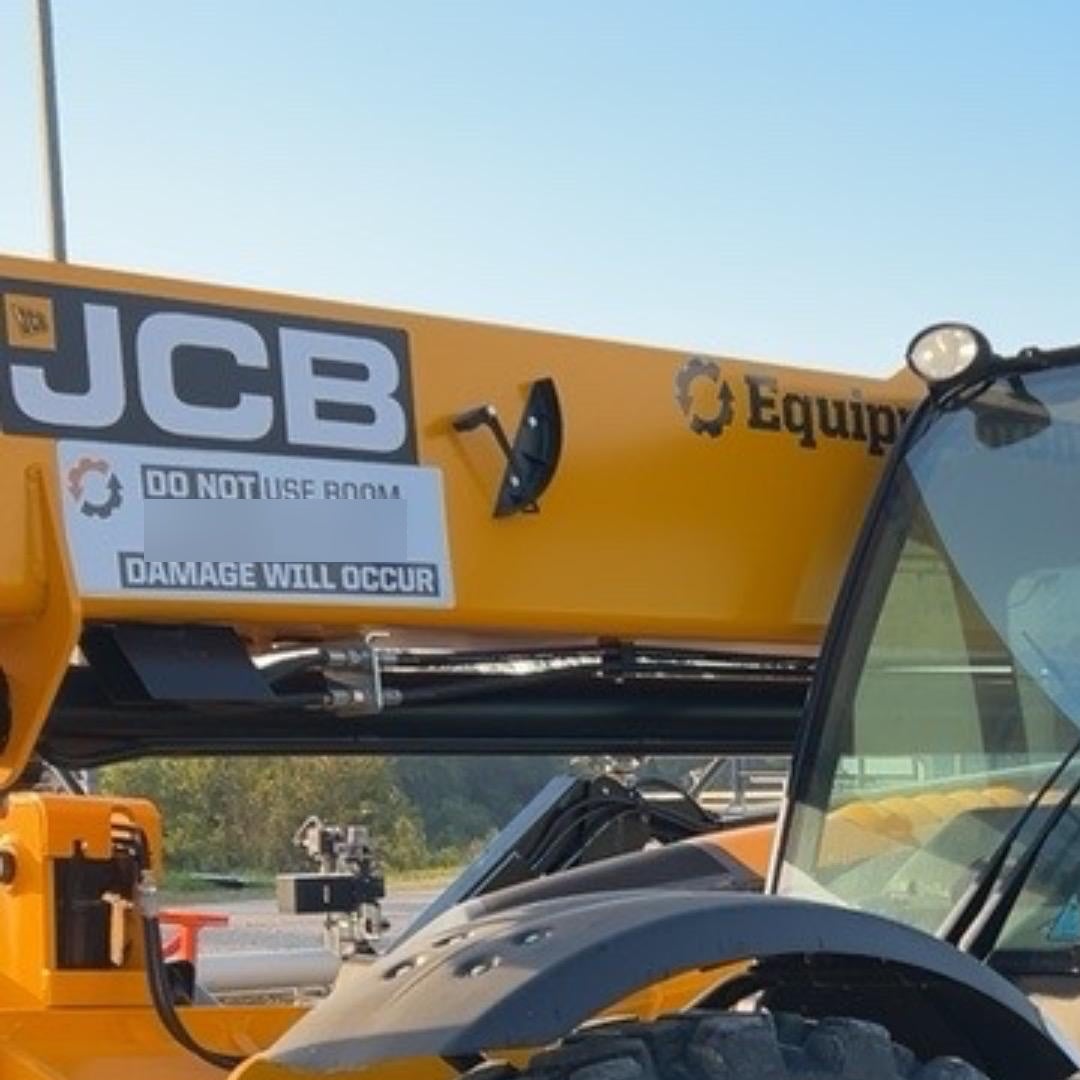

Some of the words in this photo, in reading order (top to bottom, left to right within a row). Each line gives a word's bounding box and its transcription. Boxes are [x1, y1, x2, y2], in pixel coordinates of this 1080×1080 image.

[10, 303, 408, 453] JCB
[146, 469, 190, 498] DO
[196, 473, 256, 499] NOT
[126, 556, 256, 587] DAMAGE
[261, 563, 337, 590] WILL
[341, 565, 435, 593] OCCUR
